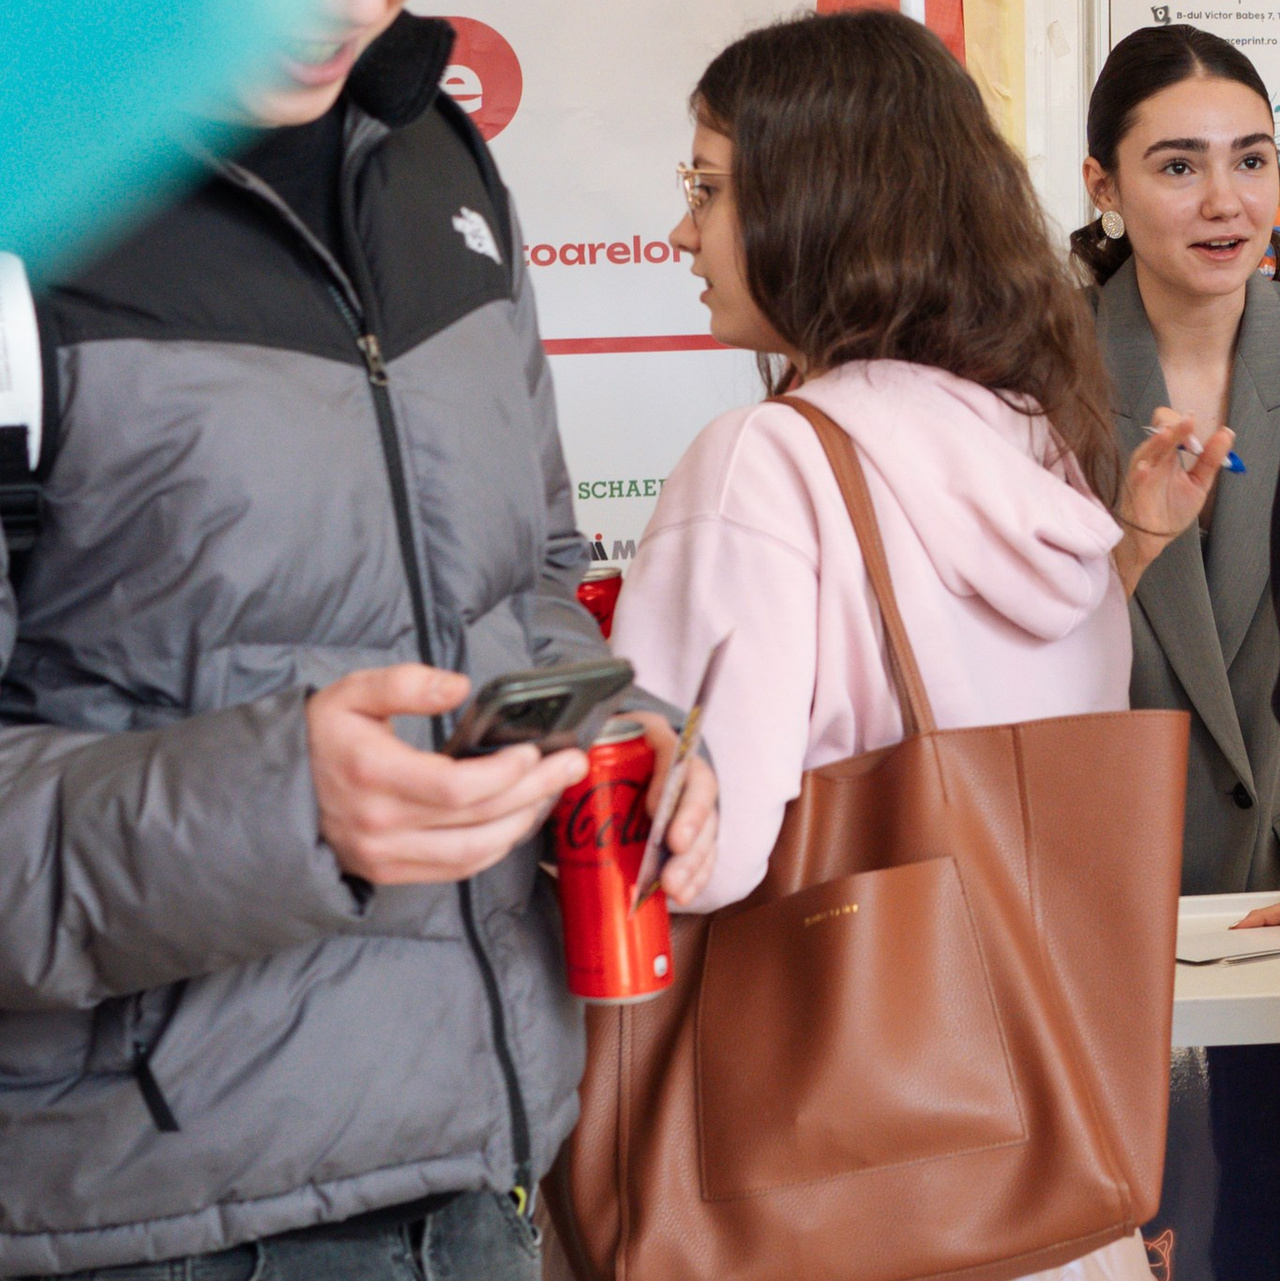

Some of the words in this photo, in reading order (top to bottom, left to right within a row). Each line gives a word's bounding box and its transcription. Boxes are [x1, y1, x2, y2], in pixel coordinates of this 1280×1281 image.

[1176, 10, 1203, 20] B-dul
[1205, 11, 1233, 20] Victor
[1235, 11, 1265, 23] Babeș
